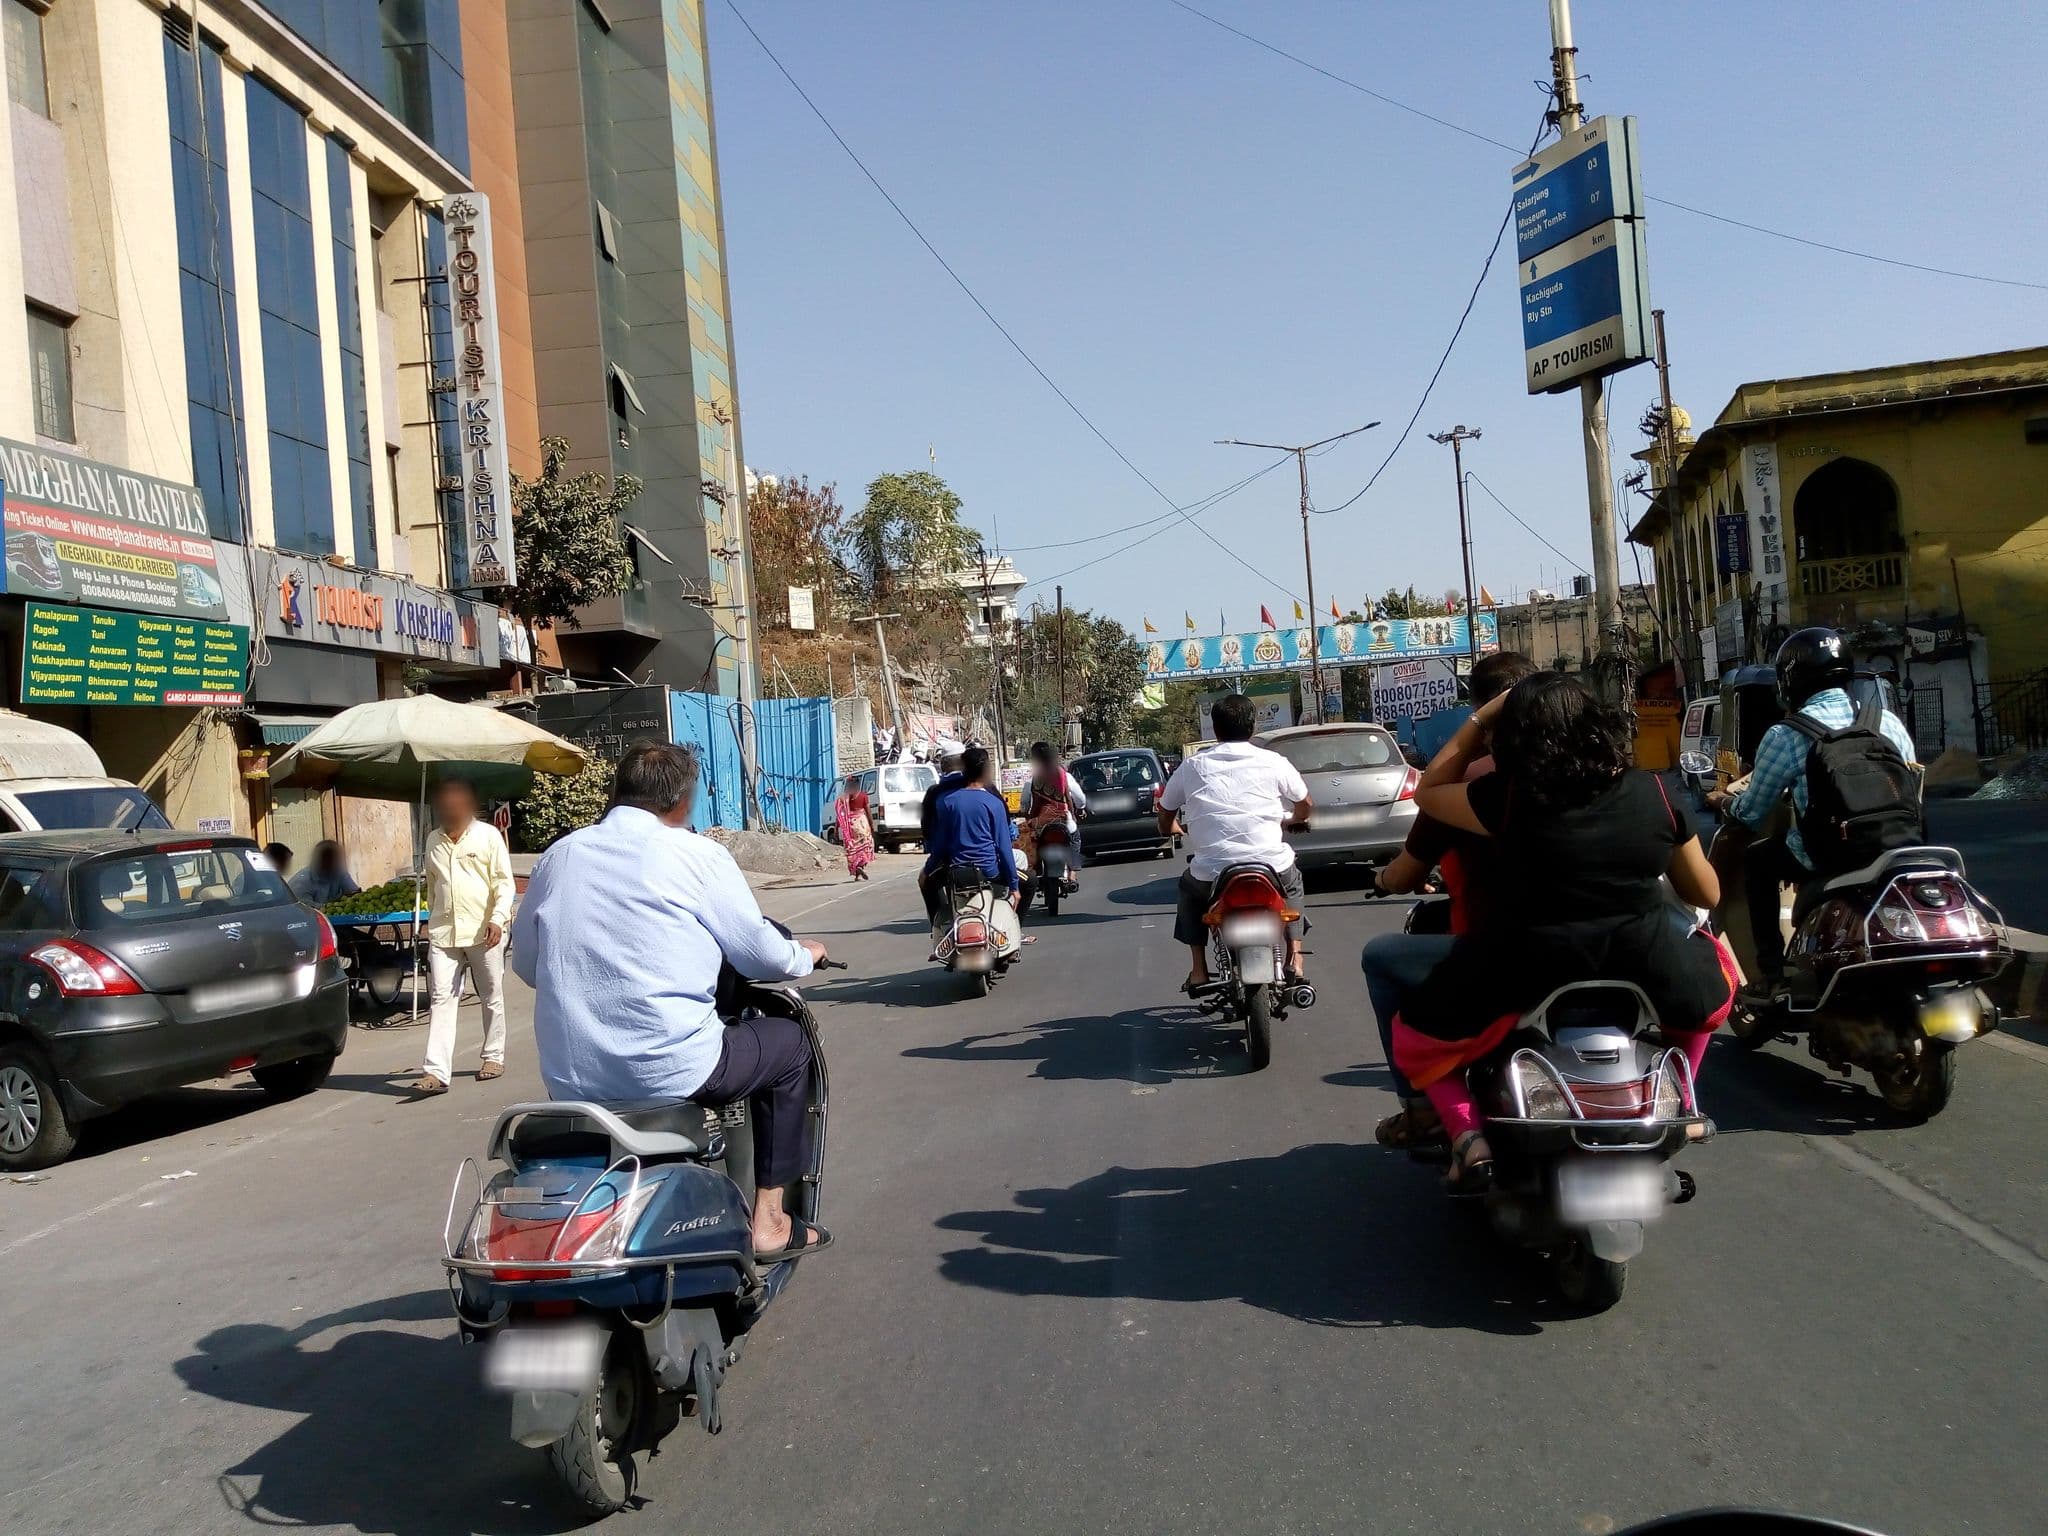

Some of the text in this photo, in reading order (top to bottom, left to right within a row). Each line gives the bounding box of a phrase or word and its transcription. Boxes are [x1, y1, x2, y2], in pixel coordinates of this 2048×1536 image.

[1583, 128, 1597, 143] km
[1516, 187, 1549, 212] Salarjung
[1519, 208, 1547, 230] Museum
[1519, 210, 1567, 243] Paigah Tombs
[1592, 232, 1605, 246] km
[1526, 281, 1563, 305] Kachiguda
[453, 226, 484, 392] TOURIST
[1527, 305, 1553, 324] Rly Stn
[1533, 333, 1613, 378] AP TOURISM
[465, 399, 500, 565] KRISHNA
[0, 446, 208, 536] MEGHANA TRAVELS
[20, 511, 45, 528] Ticket
[60, 543, 175, 577] MEGHANA CARGO CARRIERS
[72, 567, 92, 583] Help
[93, 571, 111, 585] Line
[113, 575, 120, 585] &
[121, 575, 145, 589] Phone
[34, 609, 79, 622] Amalapuram
[92, 615, 116, 626] Tanuku
[139, 620, 172, 631] Vijayawada
[91, 630, 106, 639] Tuni
[137, 635, 159, 645] Guntur
[32, 640, 66, 652] Kakinada
[174, 638, 195, 648] Ongole
[90, 645, 127, 656] Annavaram
[137, 648, 164, 659] Tirupathi
[173, 652, 197, 661] Kurnool
[32, 655, 85, 667] Visakhapatnam
[89, 660, 132, 672] Rajahmundry
[135, 663, 167, 675] Rajampeta
[1393, 660, 1425, 676] CONTACT
[31, 671, 82, 683] Vijayanagaram
[88, 676, 129, 686] Bhimavaram
[134, 678, 158, 688] Kadapa
[30, 687, 75, 699] Ravulapalem
[87, 691, 117, 701] Palakollu
[1374, 678, 1455, 704] 8008077654
[133, 693, 156, 702] Nellore
[166, 693, 242, 703] CARGO CARRIERS AVAILABLE
